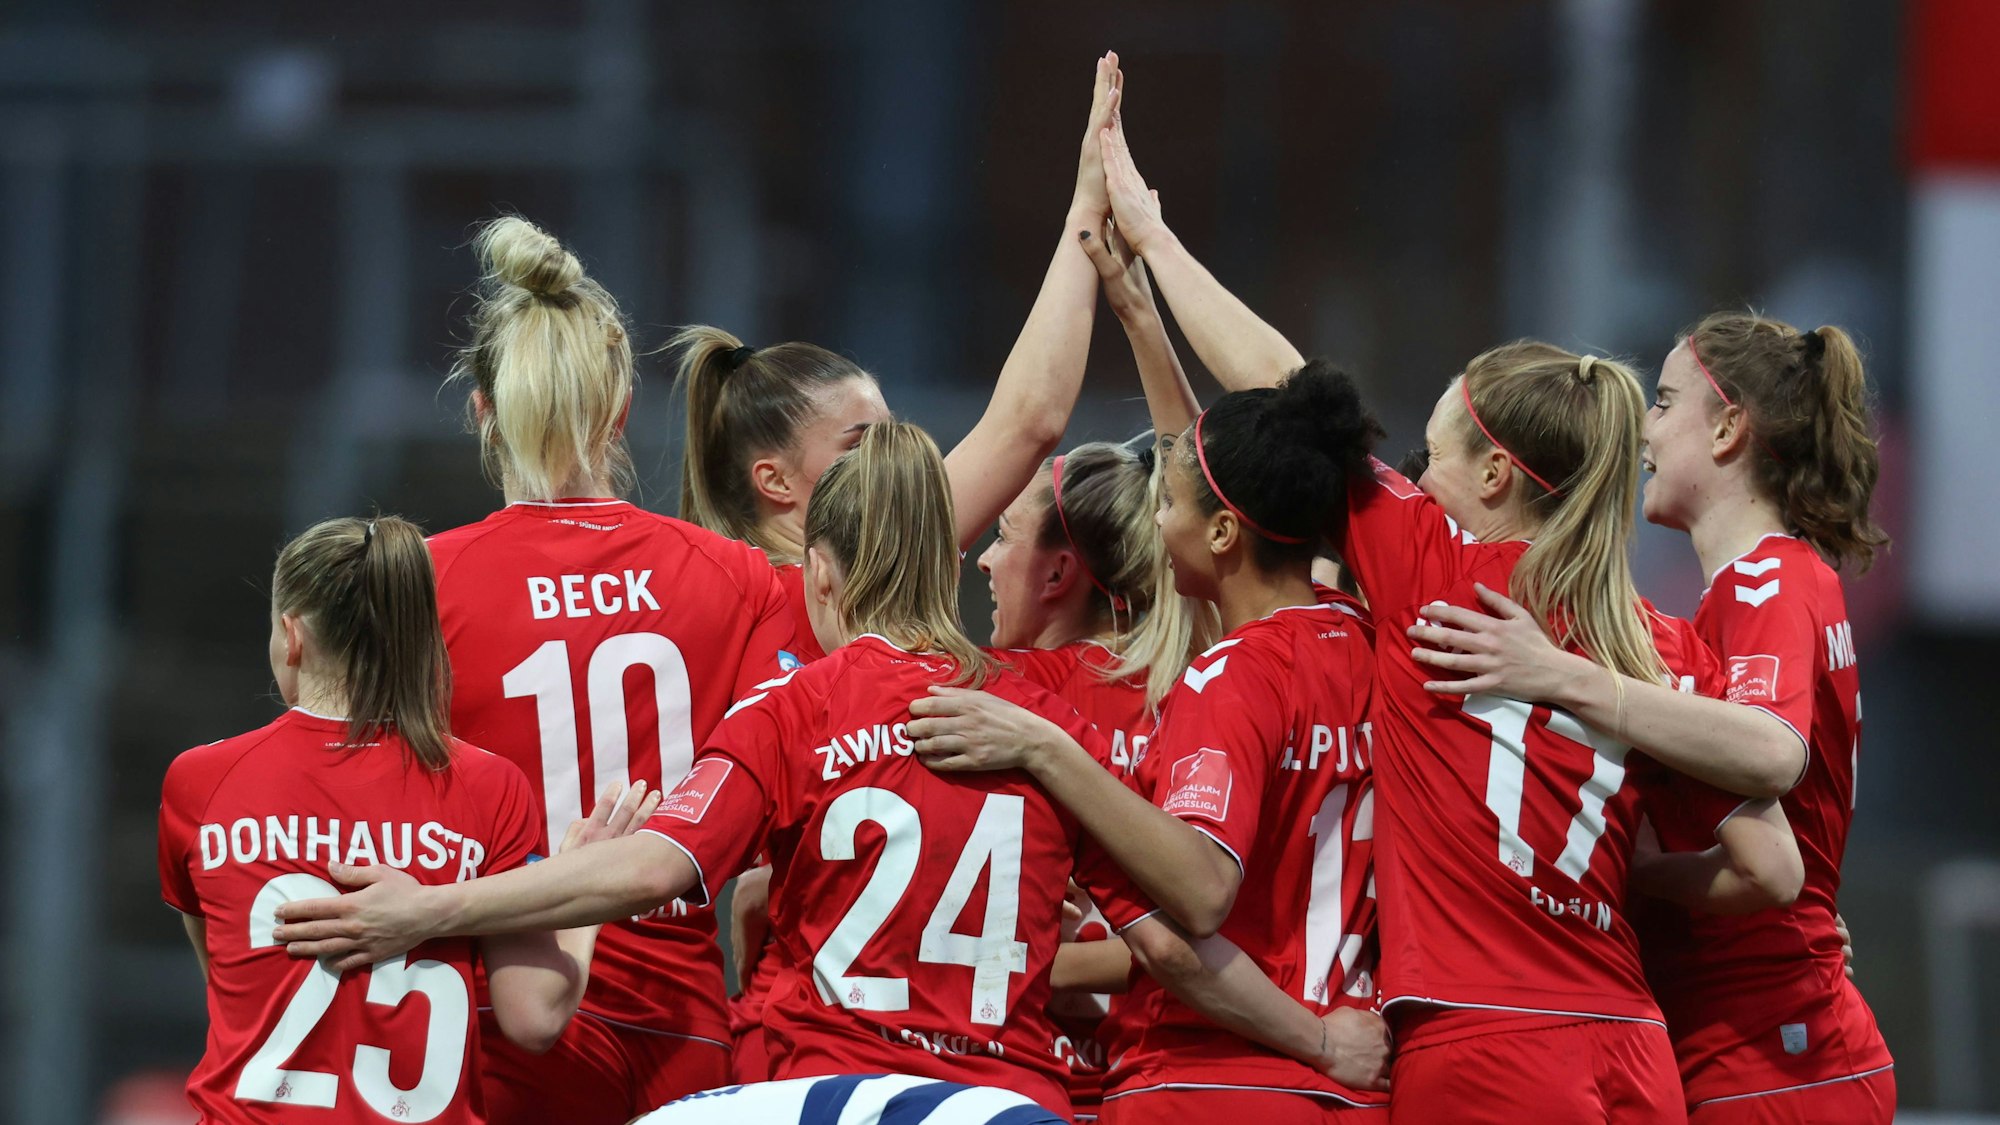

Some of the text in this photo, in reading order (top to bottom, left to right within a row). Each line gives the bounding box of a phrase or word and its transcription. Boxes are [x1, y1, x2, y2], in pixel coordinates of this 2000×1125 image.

[527, 569, 661, 619] BECK
[502, 632, 694, 857] 10
[1461, 693, 1627, 884] 17
[234, 872, 469, 1124] 25
[812, 787, 1028, 1027] 24
